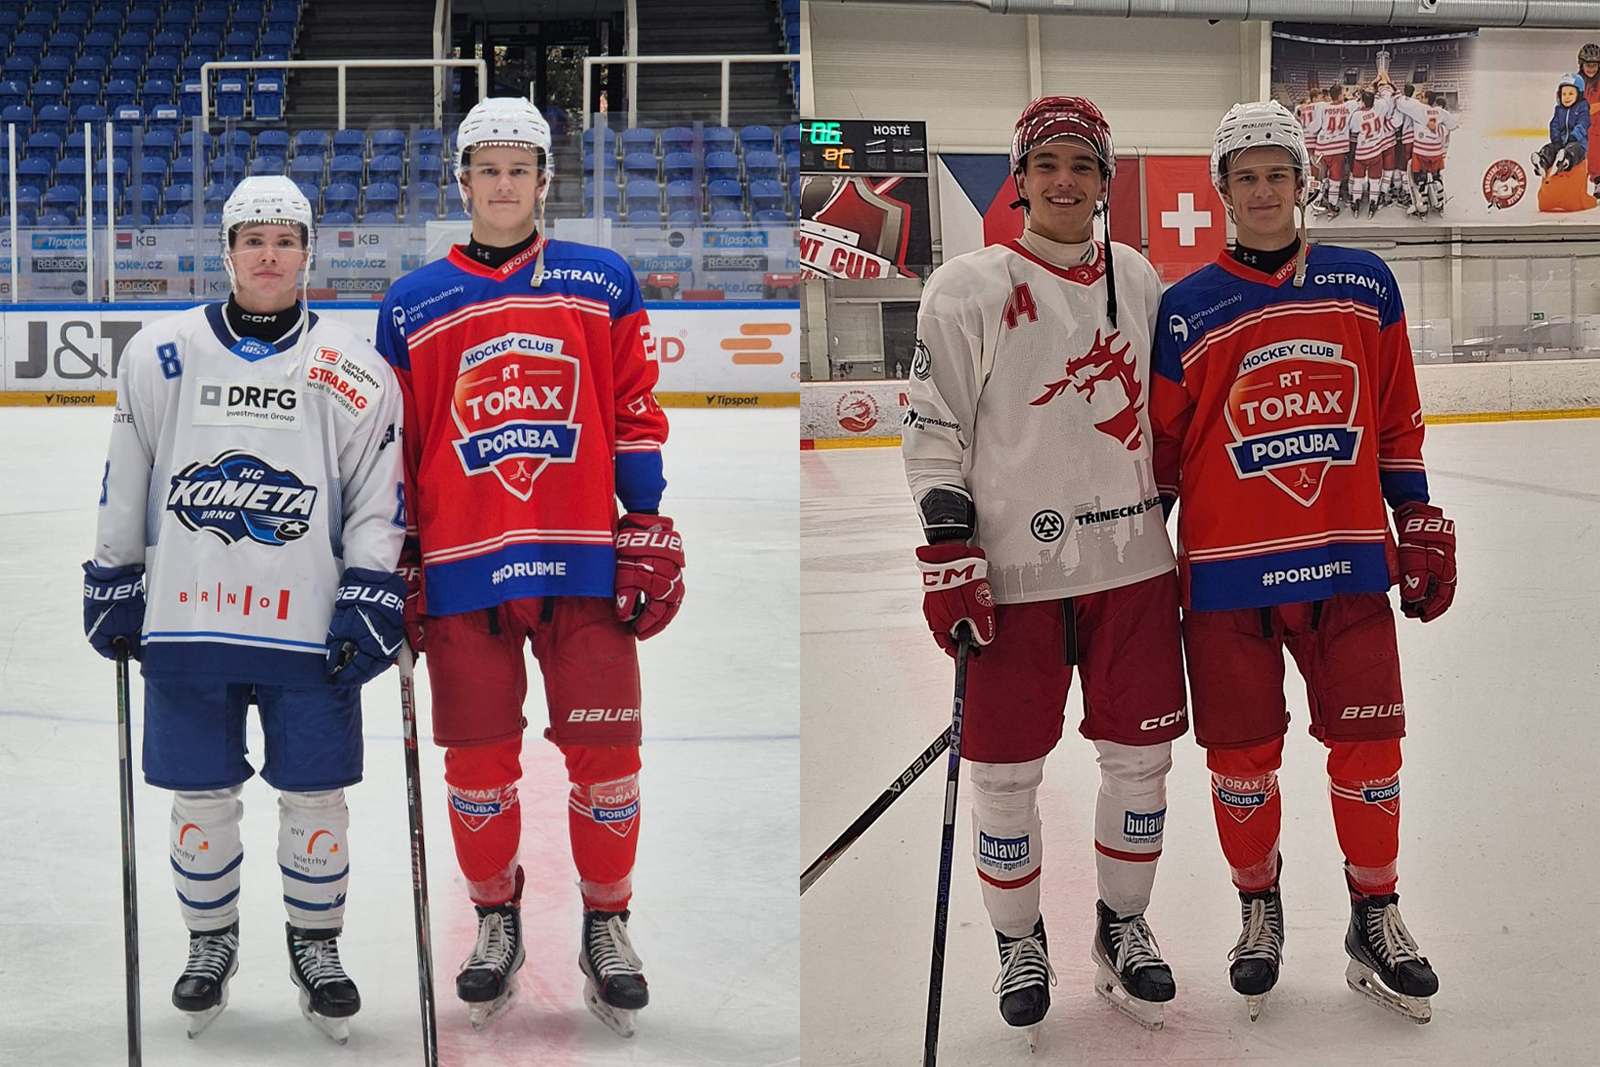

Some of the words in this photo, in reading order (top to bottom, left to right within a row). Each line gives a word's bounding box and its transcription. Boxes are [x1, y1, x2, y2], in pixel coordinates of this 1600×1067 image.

[873, 124, 911, 136] HOSTÉ
[1327, 116, 1347, 133] 44
[1361, 117, 1382, 139] 24
[47, 237, 87, 248] Tipspor
[135, 235, 157, 247] KB
[358, 234, 380, 245] KB
[718, 233, 764, 247] Tipsport
[37, 259, 87, 270] RADEGAS
[331, 258, 386, 269] hokej.cz
[642, 257, 687, 269] Tipsport
[707, 256, 763, 269] RADEGAST
[331, 279, 385, 291] RADEGAST
[406, 284, 465, 317] Moravskoslezský
[1187, 292, 1243, 324] Moravskoslezský
[241, 314, 277, 323] CCM
[409, 311, 424, 323] kraj
[15, 321, 143, 380] J&T
[465, 338, 515, 366] HOCKEY
[517, 337, 554, 353] CLUB
[1241, 345, 1297, 371] HOCKEY
[1299, 344, 1335, 358] CLUB
[156, 341, 182, 380] 8
[340, 363, 364, 383] BRNO
[343, 359, 380, 389] TEPLÁRNY
[502, 363, 520, 382] RT
[1279, 371, 1303, 388] RT
[308, 366, 368, 410] STRABAG
[55, 394, 95, 405] Tipsport
[228, 386, 297, 410] DRFG
[465, 385, 564, 421] TORAX
[716, 395, 759, 406] Tipsport
[226, 409, 268, 420] Investment
[270, 413, 295, 422] Group
[1239, 390, 1344, 425] TORAX
[478, 428, 560, 459] PORUBA
[1251, 433, 1340, 463] PORUBA
[239, 467, 265, 480] HC
[168, 479, 316, 516] KOMETA
[201, 510, 236, 520] BRNO
[1075, 501, 1144, 526] TŘINECKÉ
[85, 580, 144, 600] AUER
[1139, 706, 1188, 732] CCM
[1219, 776, 1260, 790] TORAX
[1221, 791, 1260, 805] PORUBA
[1370, 785, 1400, 799] PORUB
[454, 799, 496, 813] PORUBA
[981, 834, 1027, 859] bulawa
